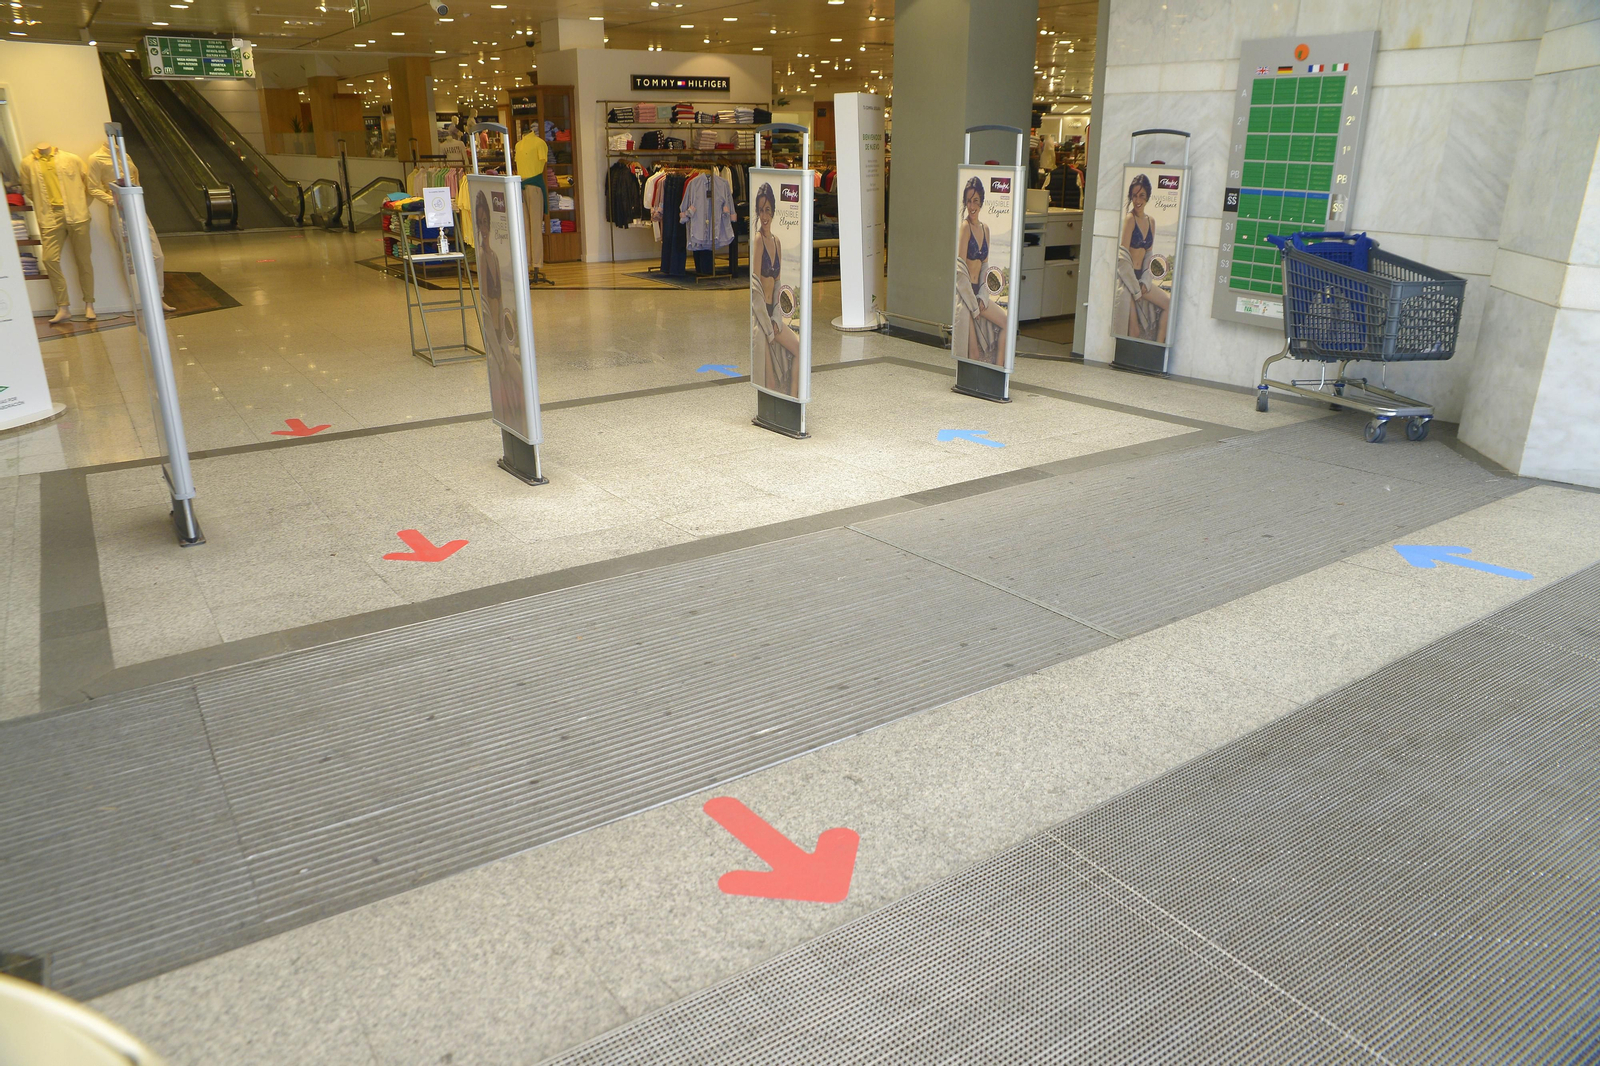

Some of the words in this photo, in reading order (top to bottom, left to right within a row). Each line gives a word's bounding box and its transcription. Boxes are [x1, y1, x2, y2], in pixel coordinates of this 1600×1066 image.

[636, 78, 674, 86] TOMMY
[1241, 89, 1247, 97] A
[1351, 86, 1358, 96] A
[1230, 170, 1240, 179] PB
[1336, 174, 1348, 184] PB
[1227, 196, 1237, 205] SS
[1155, 200, 1177, 211] Elegance
[1332, 203, 1343, 212] SS
[776, 210, 798, 218] INVISIBLE
[988, 206, 1010, 218] Elegance
[1222, 243, 1231, 252] S2
[1221, 260, 1229, 268] S3
